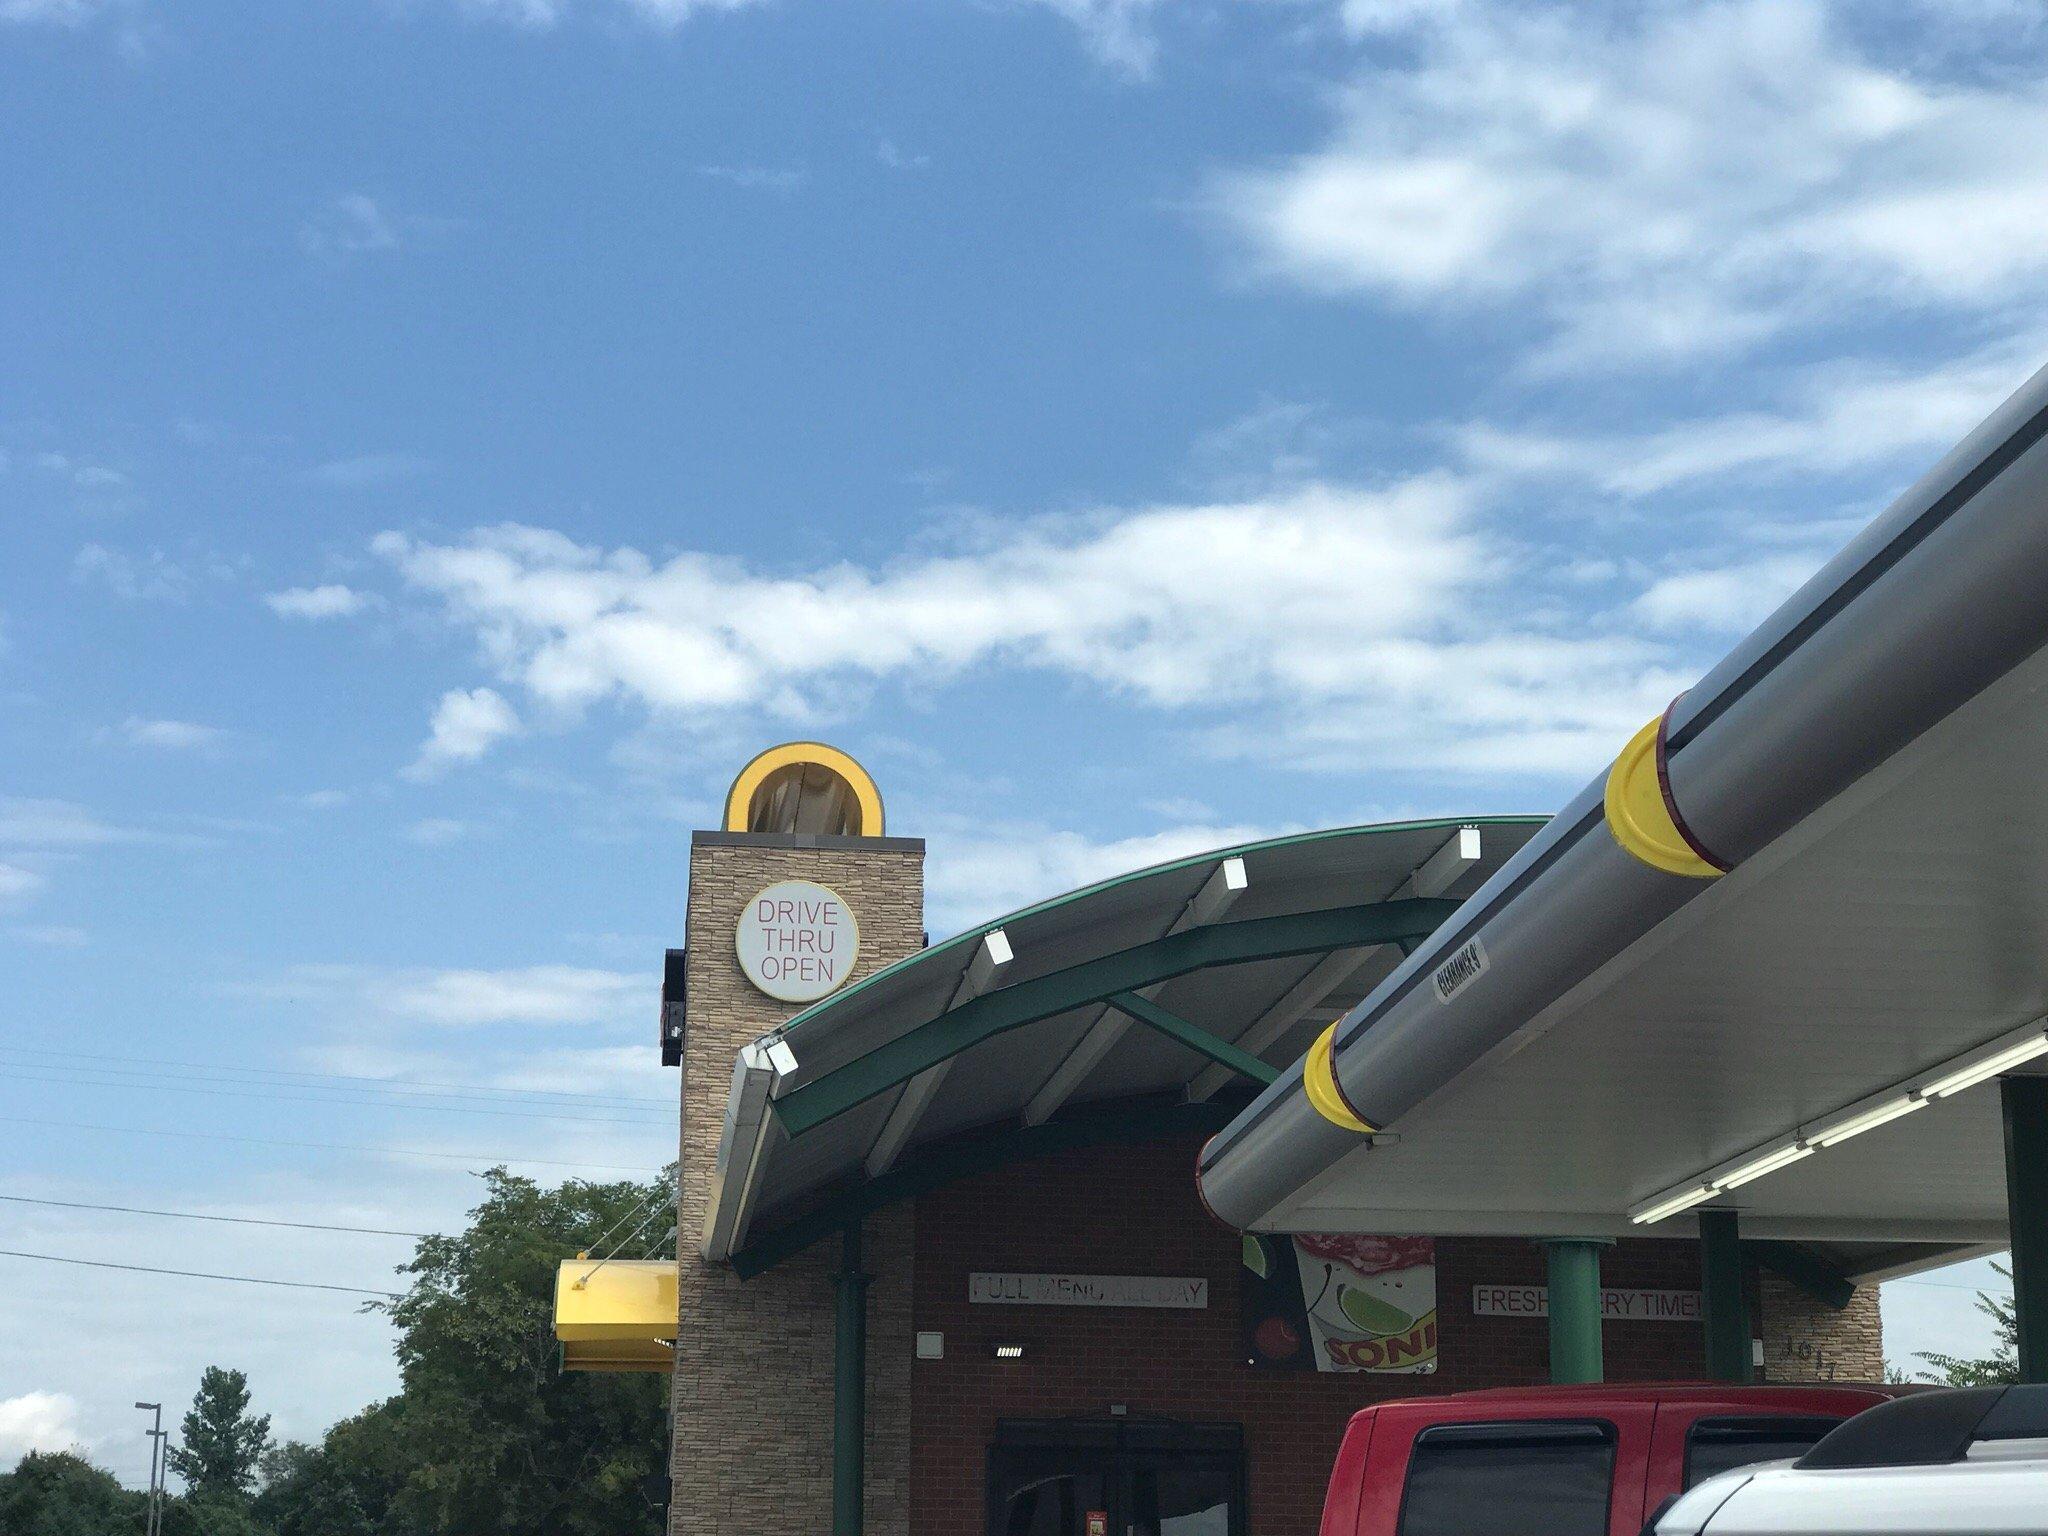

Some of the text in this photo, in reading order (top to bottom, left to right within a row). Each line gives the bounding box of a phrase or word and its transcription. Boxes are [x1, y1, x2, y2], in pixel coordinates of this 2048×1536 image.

[758, 899, 838, 926] DRIVE
[761, 927, 834, 954] THRU
[761, 956, 833, 982] OPEN
[1436, 947, 1477, 998] CLEARANCE
[973, 1276, 1030, 1300] FULL
[1038, 1277, 1105, 1302] MENU
